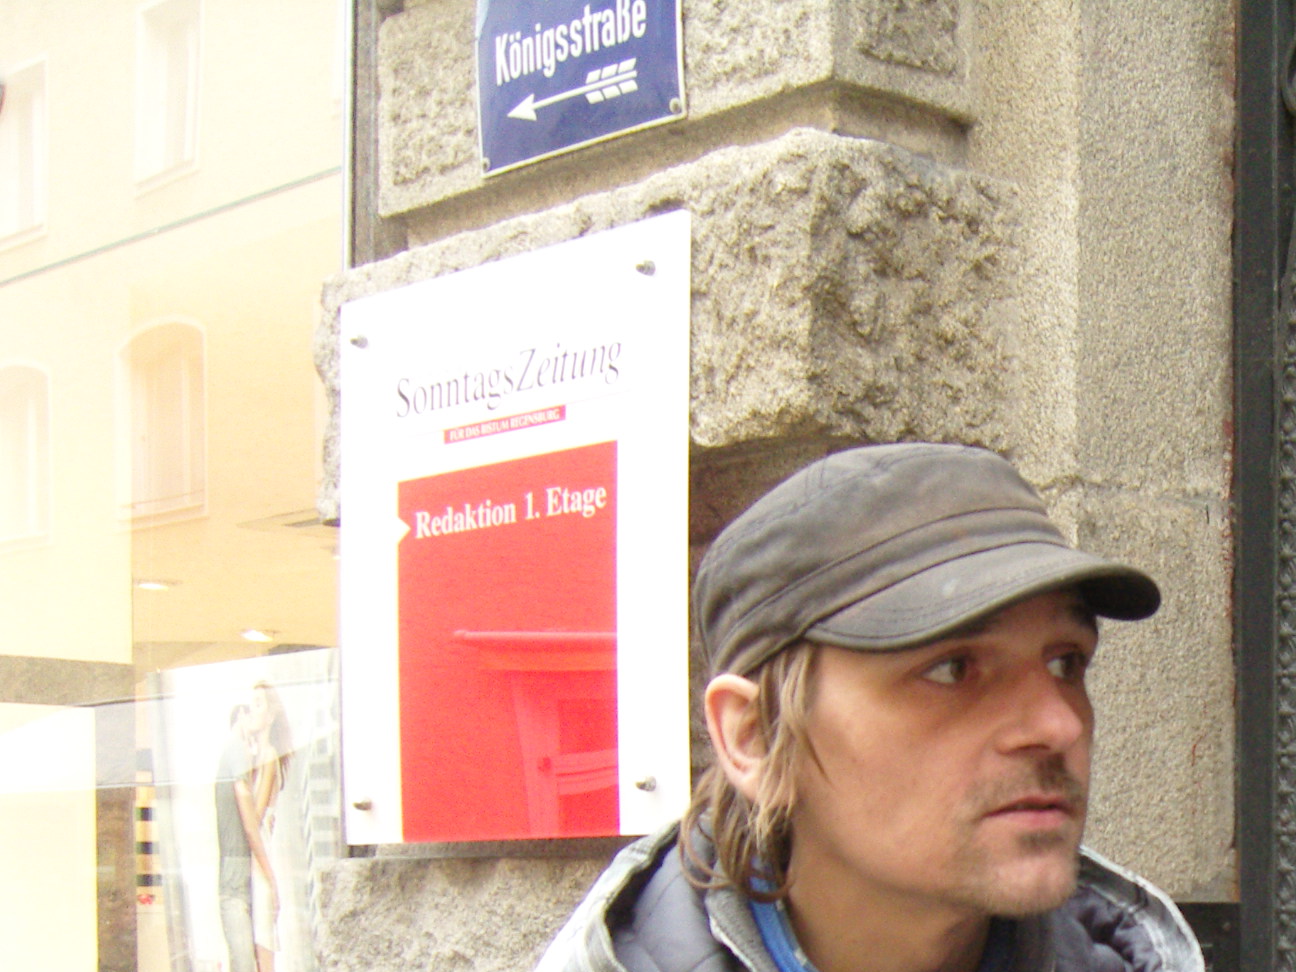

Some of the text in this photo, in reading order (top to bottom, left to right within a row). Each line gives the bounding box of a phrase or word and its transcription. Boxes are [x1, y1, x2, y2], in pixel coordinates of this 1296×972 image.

[495, 0, 647, 86] Königsstraße
[396, 341, 622, 418] SonntagsZeitung
[510, 407, 560, 428] REGENSBURG
[414, 486, 608, 539] Redaktion 1. Etage
